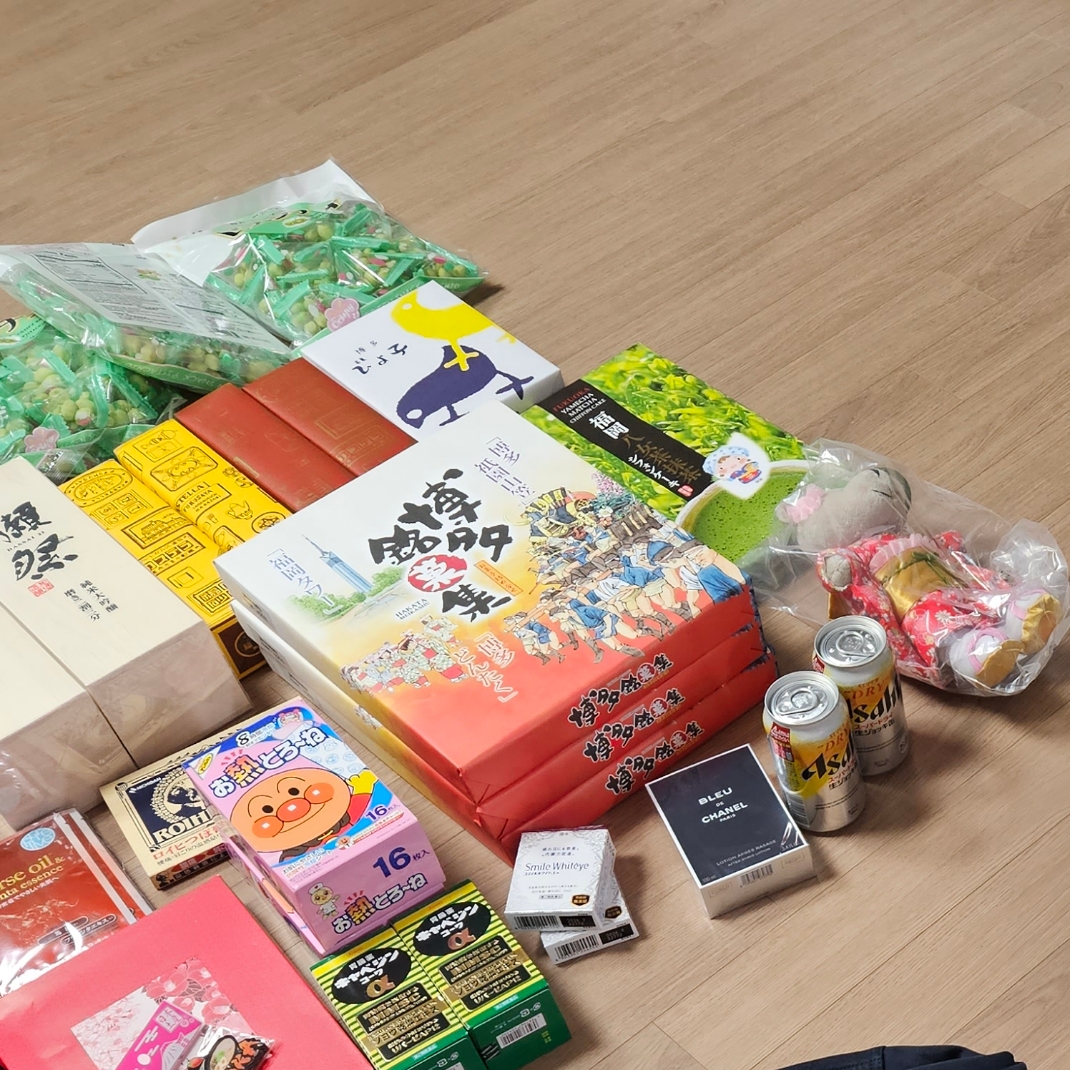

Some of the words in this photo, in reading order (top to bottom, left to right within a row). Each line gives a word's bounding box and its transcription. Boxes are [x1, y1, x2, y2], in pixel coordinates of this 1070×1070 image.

[552, 387, 591, 413] FUKUOKA
[560, 392, 595, 415] YAMECHA
[568, 397, 598, 418] MATCHA
[589, 410, 630, 440] 福岡
[395, 599, 428, 618] HAKATA
[698, 787, 733, 805] BLEU
[701, 801, 749, 823] CHANEL
[719, 813, 737, 822] PARIS
[28, 854, 54, 874] oil
[55, 856, 65, 864] &
[524, 862, 551, 872] Smile
[716, 855, 737, 867] LOTION
[20, 865, 64, 889] essence
